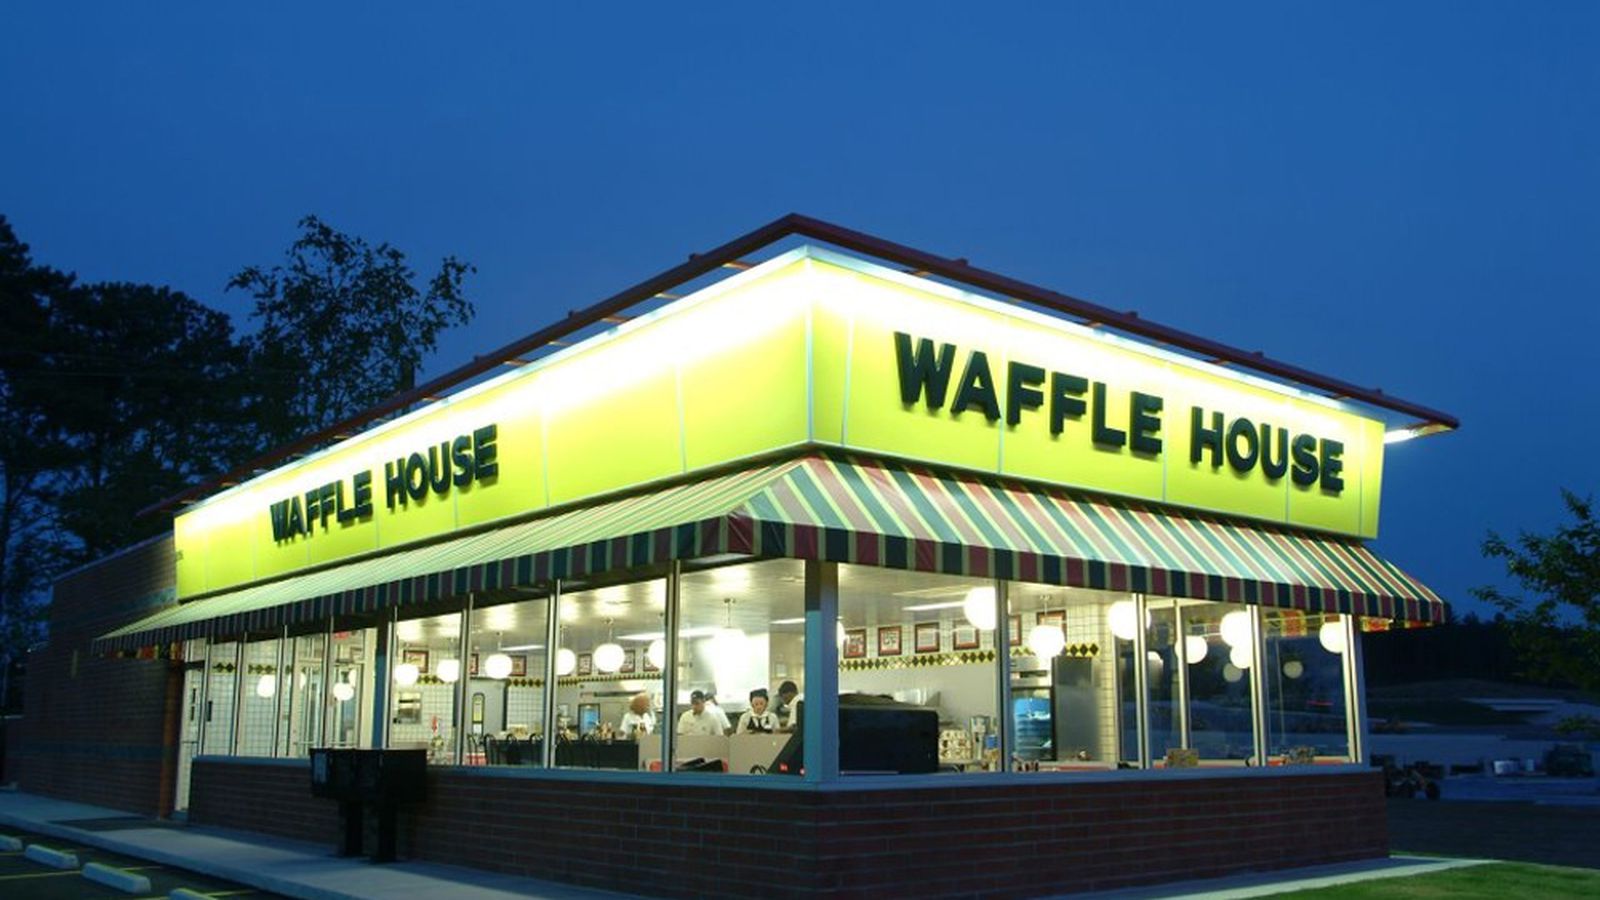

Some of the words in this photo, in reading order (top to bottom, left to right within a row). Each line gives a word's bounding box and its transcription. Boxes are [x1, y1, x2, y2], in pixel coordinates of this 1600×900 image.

[894, 331, 1163, 454] WAFFLE
[1190, 406, 1344, 493] HOUSE
[270, 470, 373, 542] WAFFLE
[385, 424, 498, 508] HOUSE
